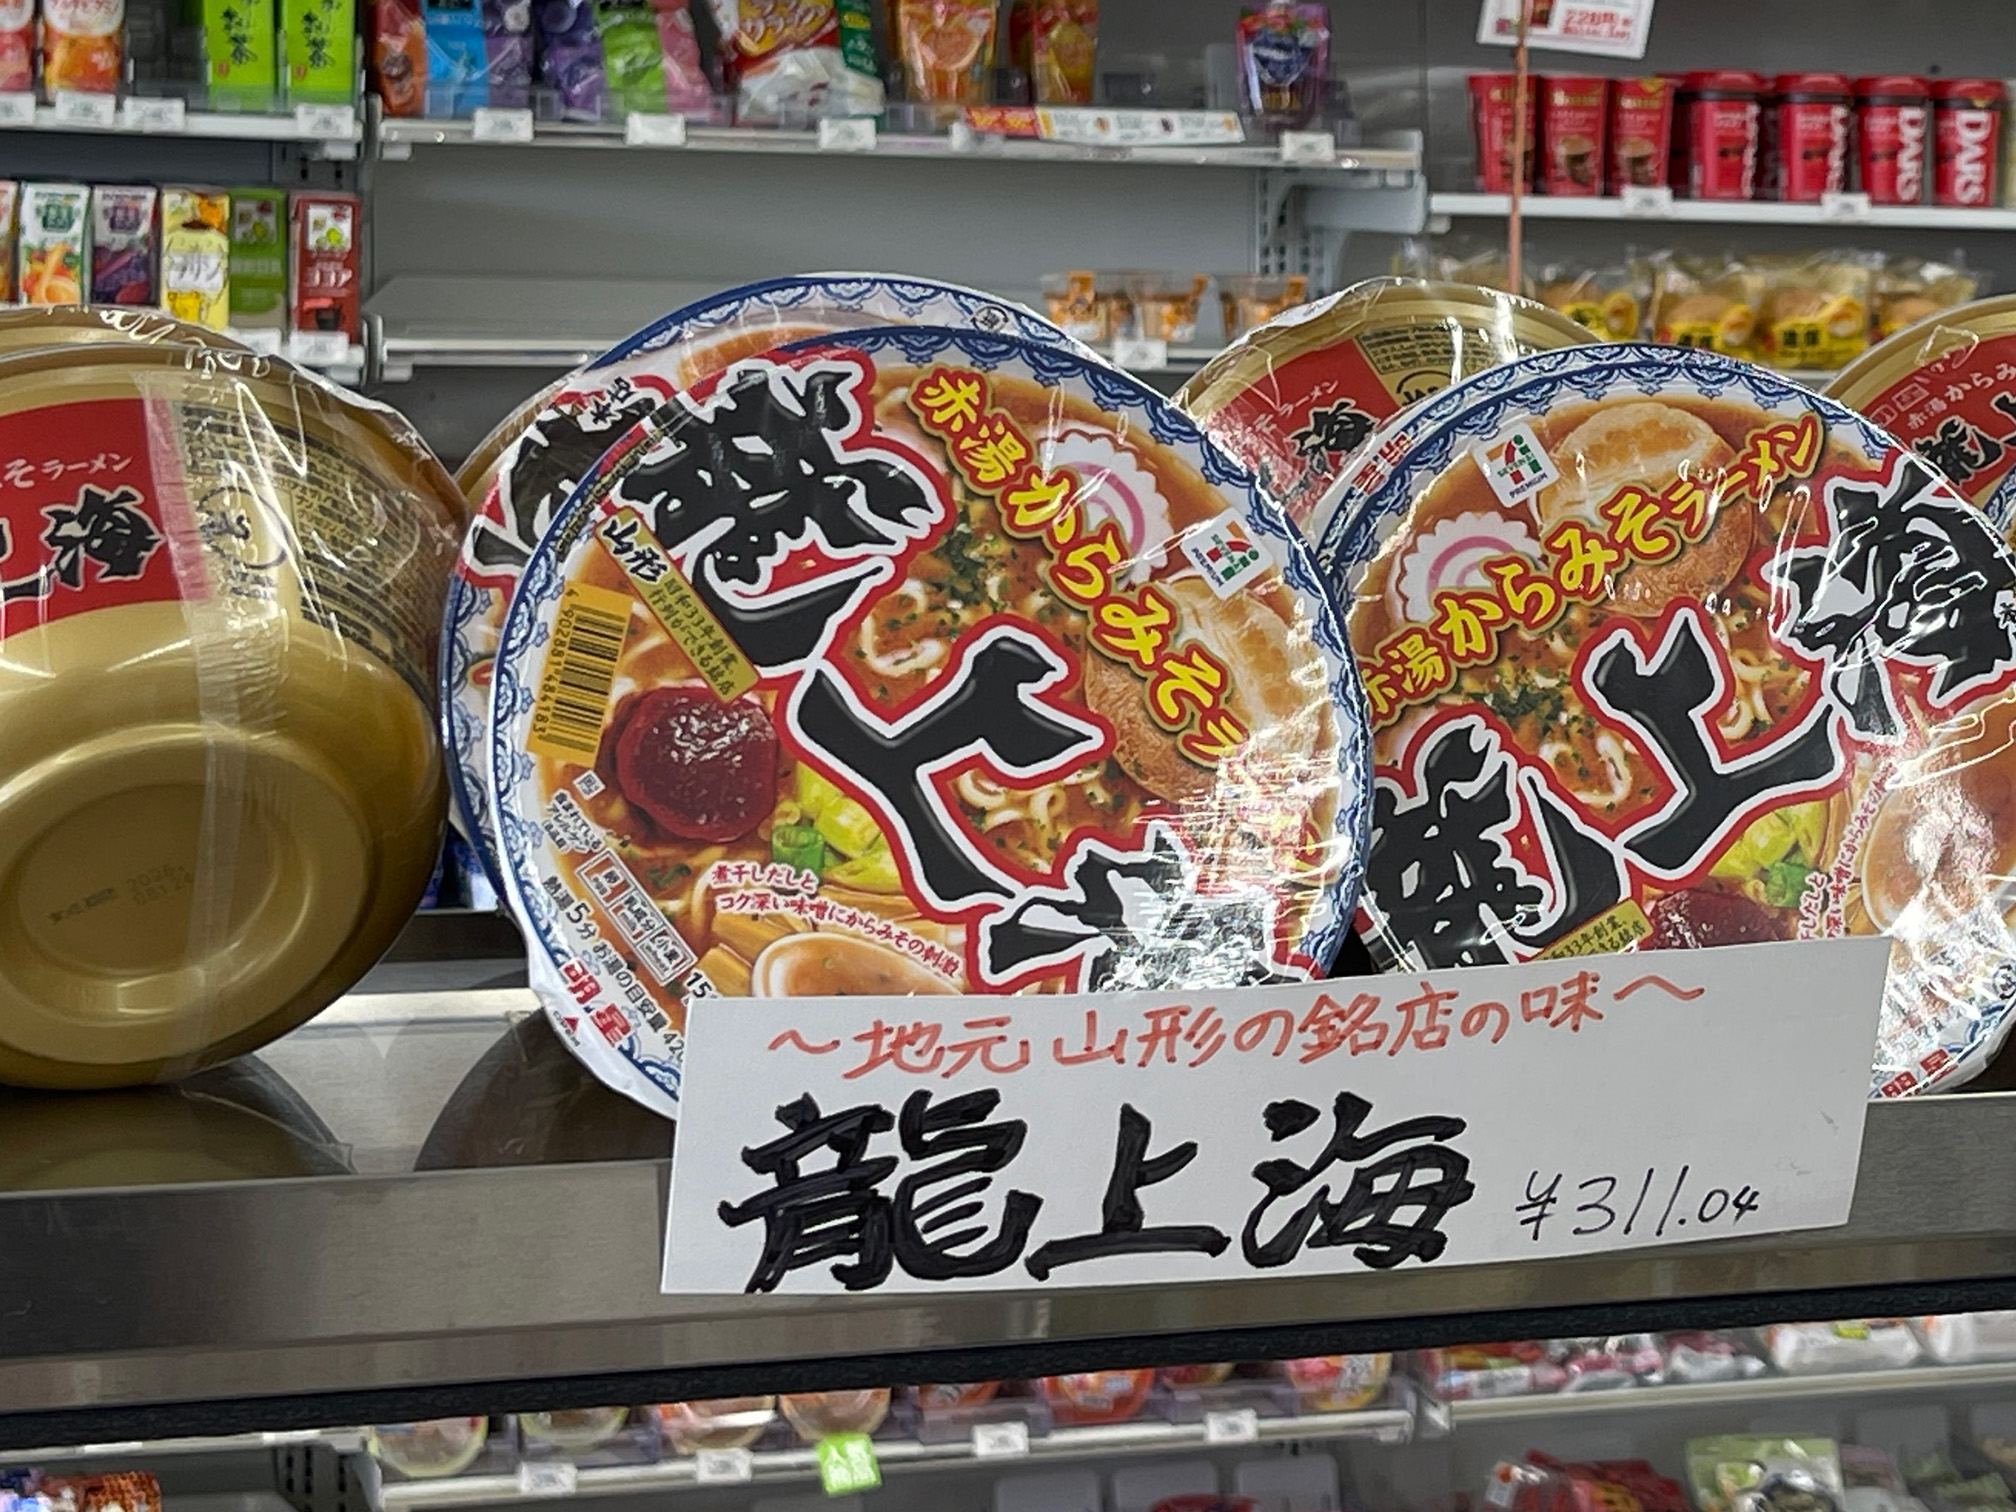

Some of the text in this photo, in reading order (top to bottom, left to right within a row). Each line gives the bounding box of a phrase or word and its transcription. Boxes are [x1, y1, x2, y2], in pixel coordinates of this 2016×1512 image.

[1953, 110, 1992, 204] DARS
[1509, 472, 1548, 499] PREMIUM
[602, 518, 669, 583] 山形
[551, 608, 575, 667] 902881
[532, 673, 559, 734] 484183
[543, 875, 597, 940] 熱湯5分
[711, 864, 819, 891] 煮干しだしと
[654, 932, 680, 964] 小麦
[718, 892, 961, 979] コク深い味噌にからみその刺激
[717, 1090, 1761, 1295] 龍上海 ¥311.04
